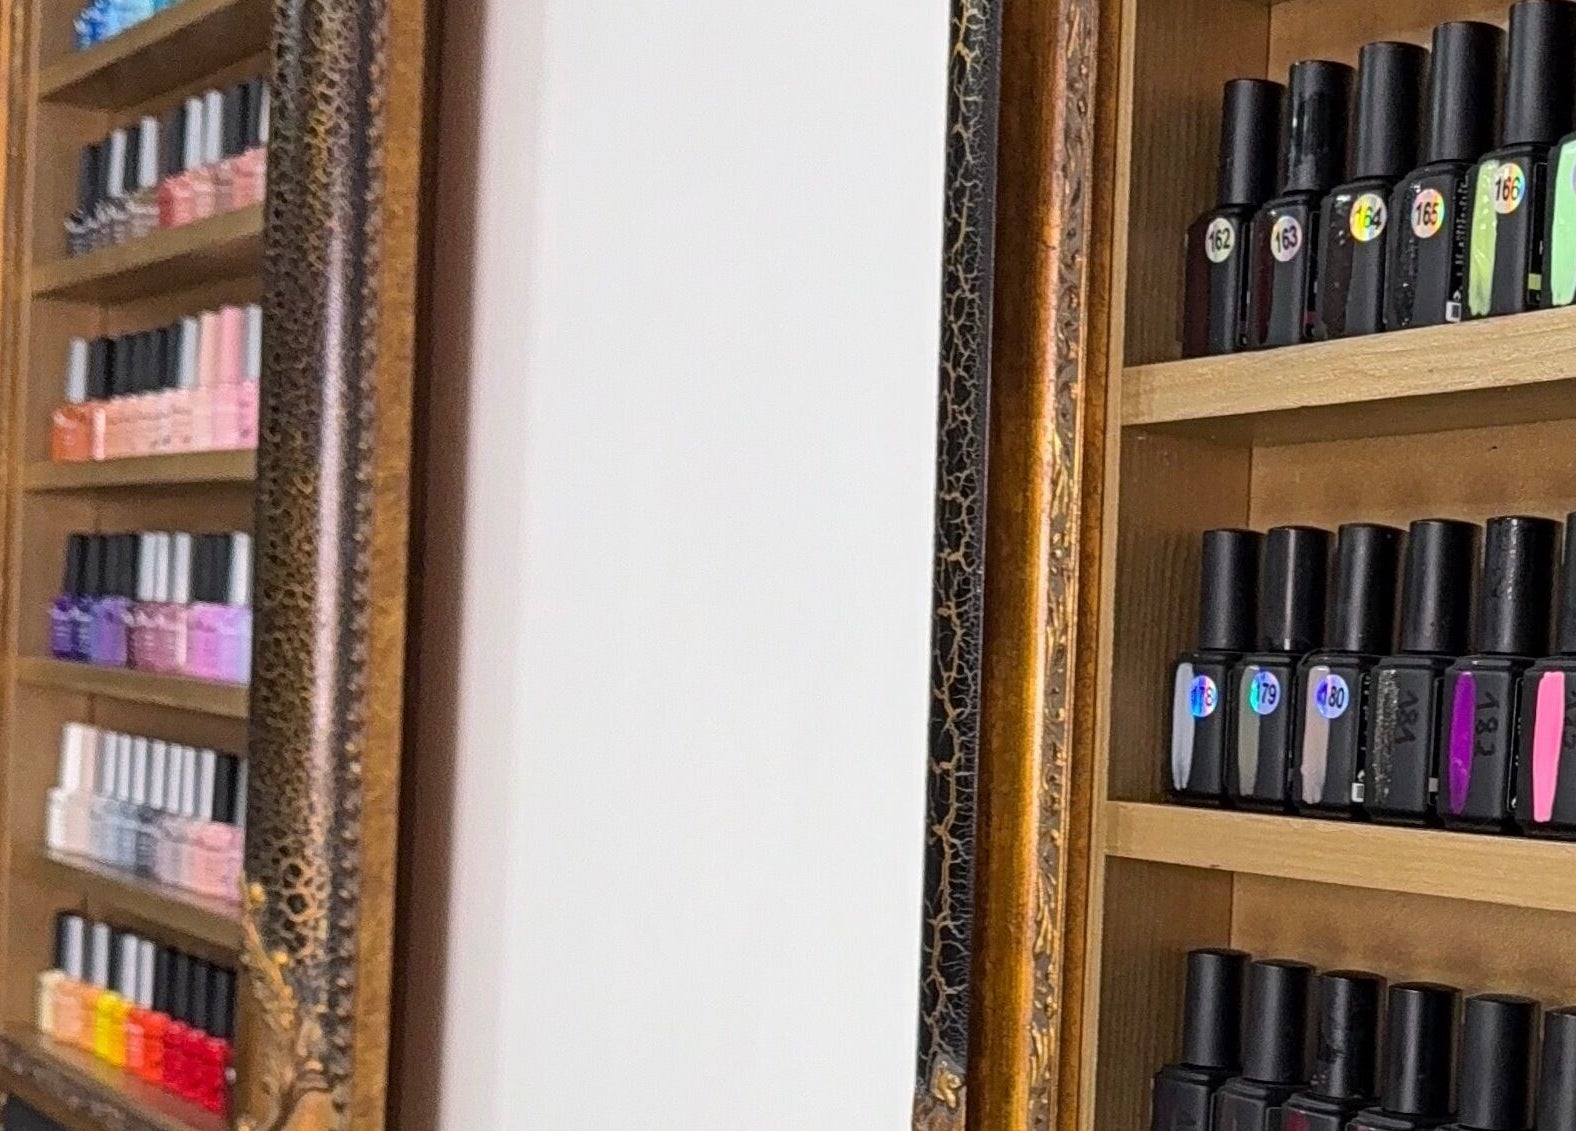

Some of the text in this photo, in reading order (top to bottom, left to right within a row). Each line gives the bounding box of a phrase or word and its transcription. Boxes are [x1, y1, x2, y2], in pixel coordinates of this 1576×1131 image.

[1494, 176, 1522, 201] 166
[1356, 205, 1382, 230] 164
[1416, 201, 1439, 226] 165
[1208, 228, 1230, 253] 162
[1276, 225, 1299, 253] 163
[1253, 682, 1277, 705] 179
[1318, 685, 1345, 709] 180
